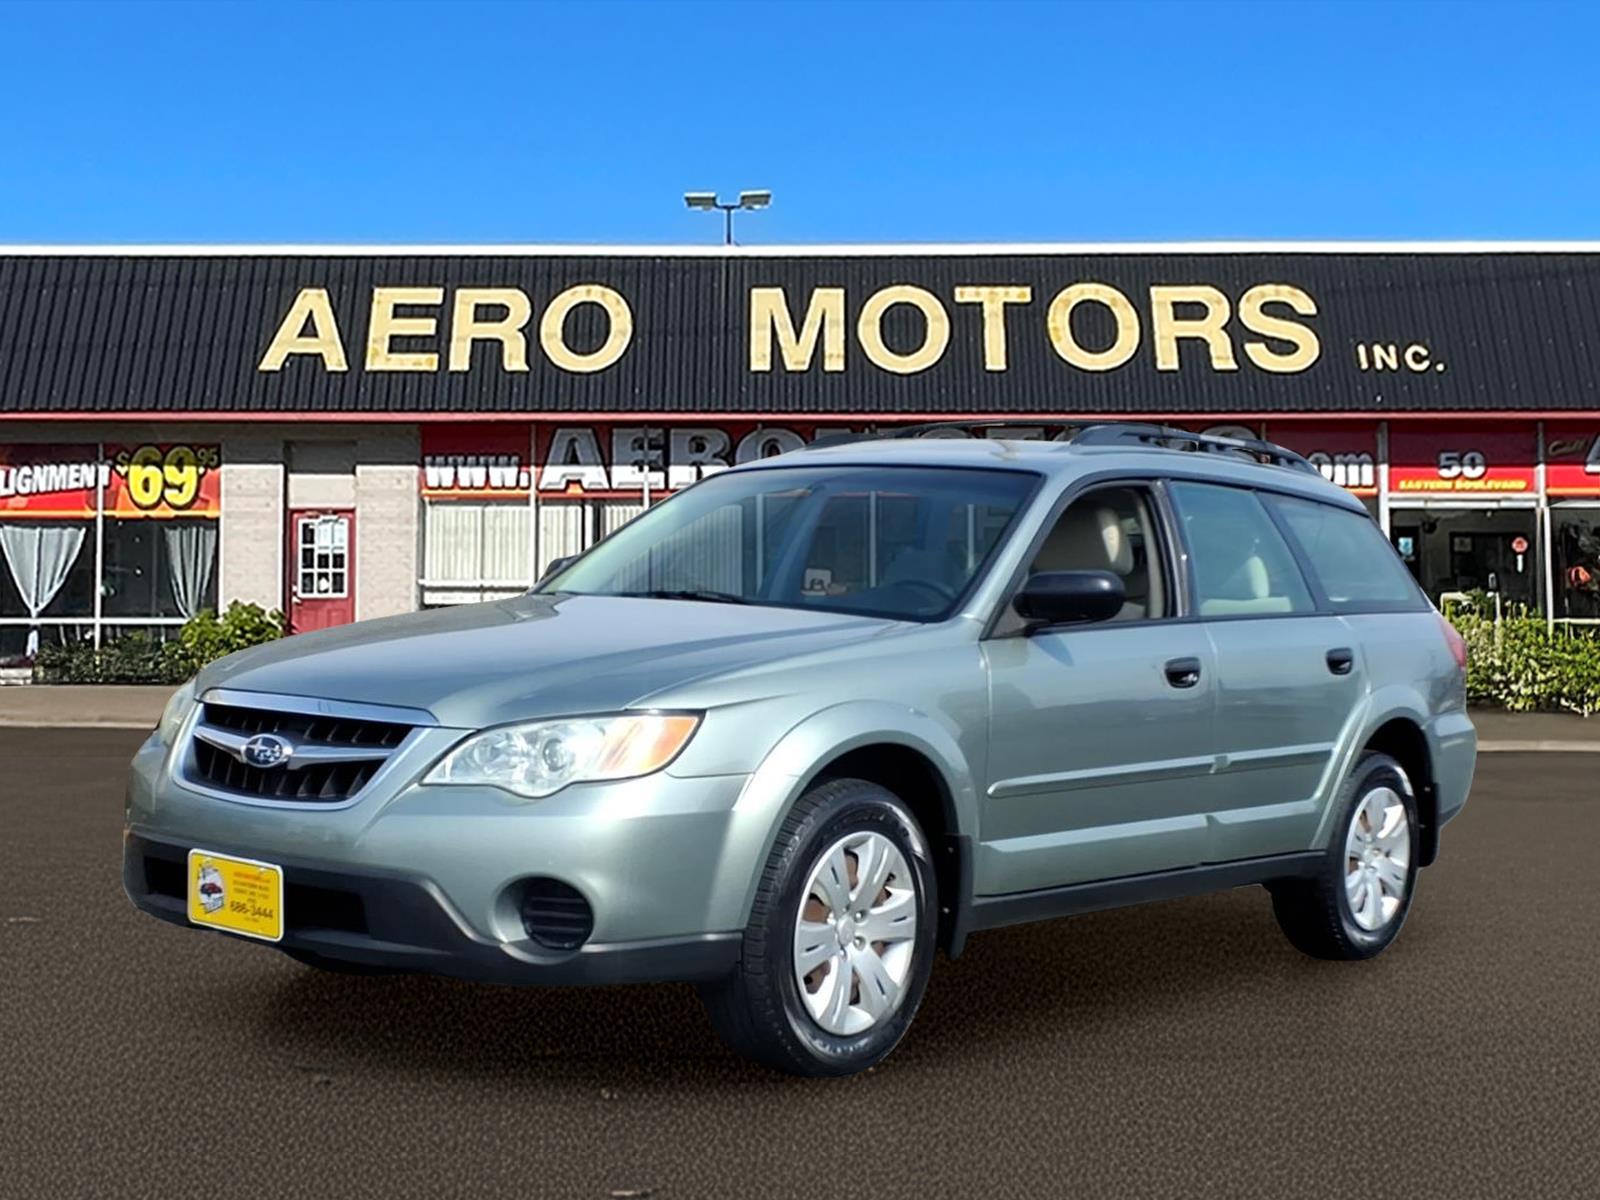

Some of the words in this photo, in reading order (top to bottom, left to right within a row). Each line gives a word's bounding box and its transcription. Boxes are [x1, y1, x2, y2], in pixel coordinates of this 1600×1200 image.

[258, 284, 633, 373] AERO
[750, 281, 1320, 374] MOTORS
[1357, 343, 1447, 372] INC.
[1438, 452, 1486, 478] 50
[1399, 480, 1452, 490] EASTERN
[1455, 480, 1527, 490] BOULEVARD
